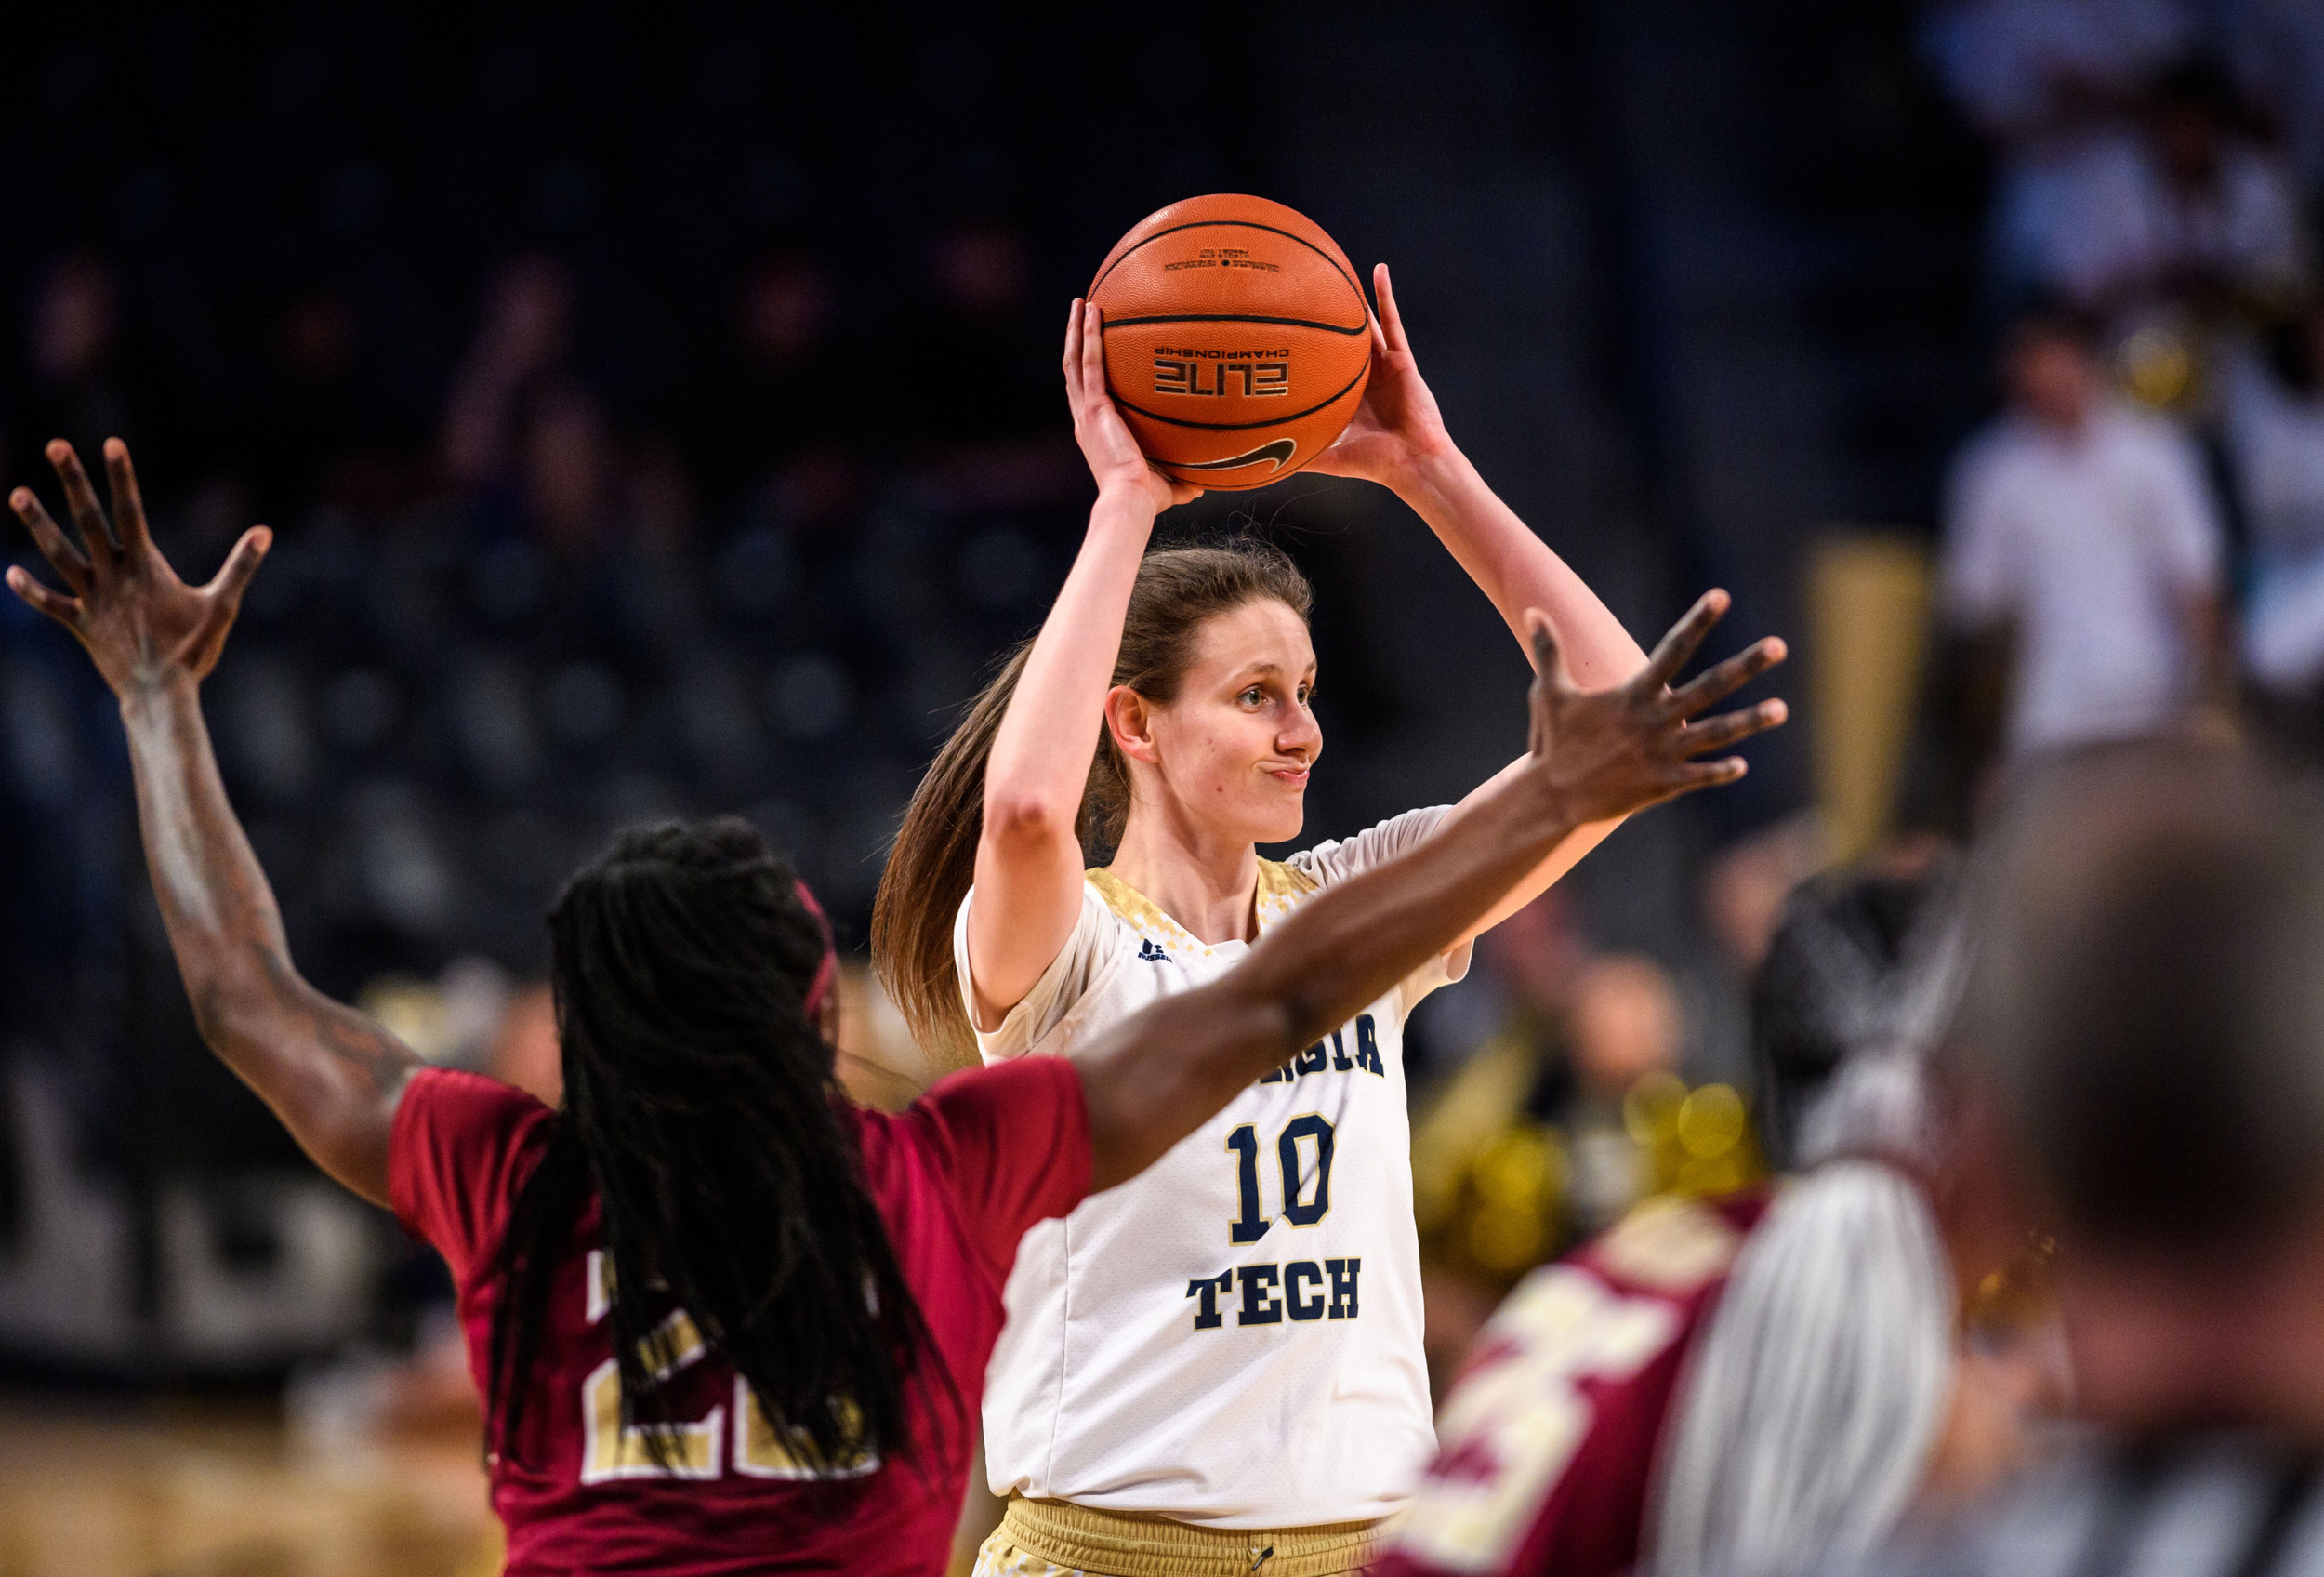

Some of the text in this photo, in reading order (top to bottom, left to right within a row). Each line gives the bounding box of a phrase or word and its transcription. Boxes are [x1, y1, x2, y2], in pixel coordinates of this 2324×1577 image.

[1154, 348, 1289, 359] CHAMPIONSHIP
[1154, 359, 1288, 397] ELITE
[1137, 951, 1173, 963] RUSSELL
[1224, 1111, 1338, 1247] 10
[1185, 1257, 1361, 1332] TECH
